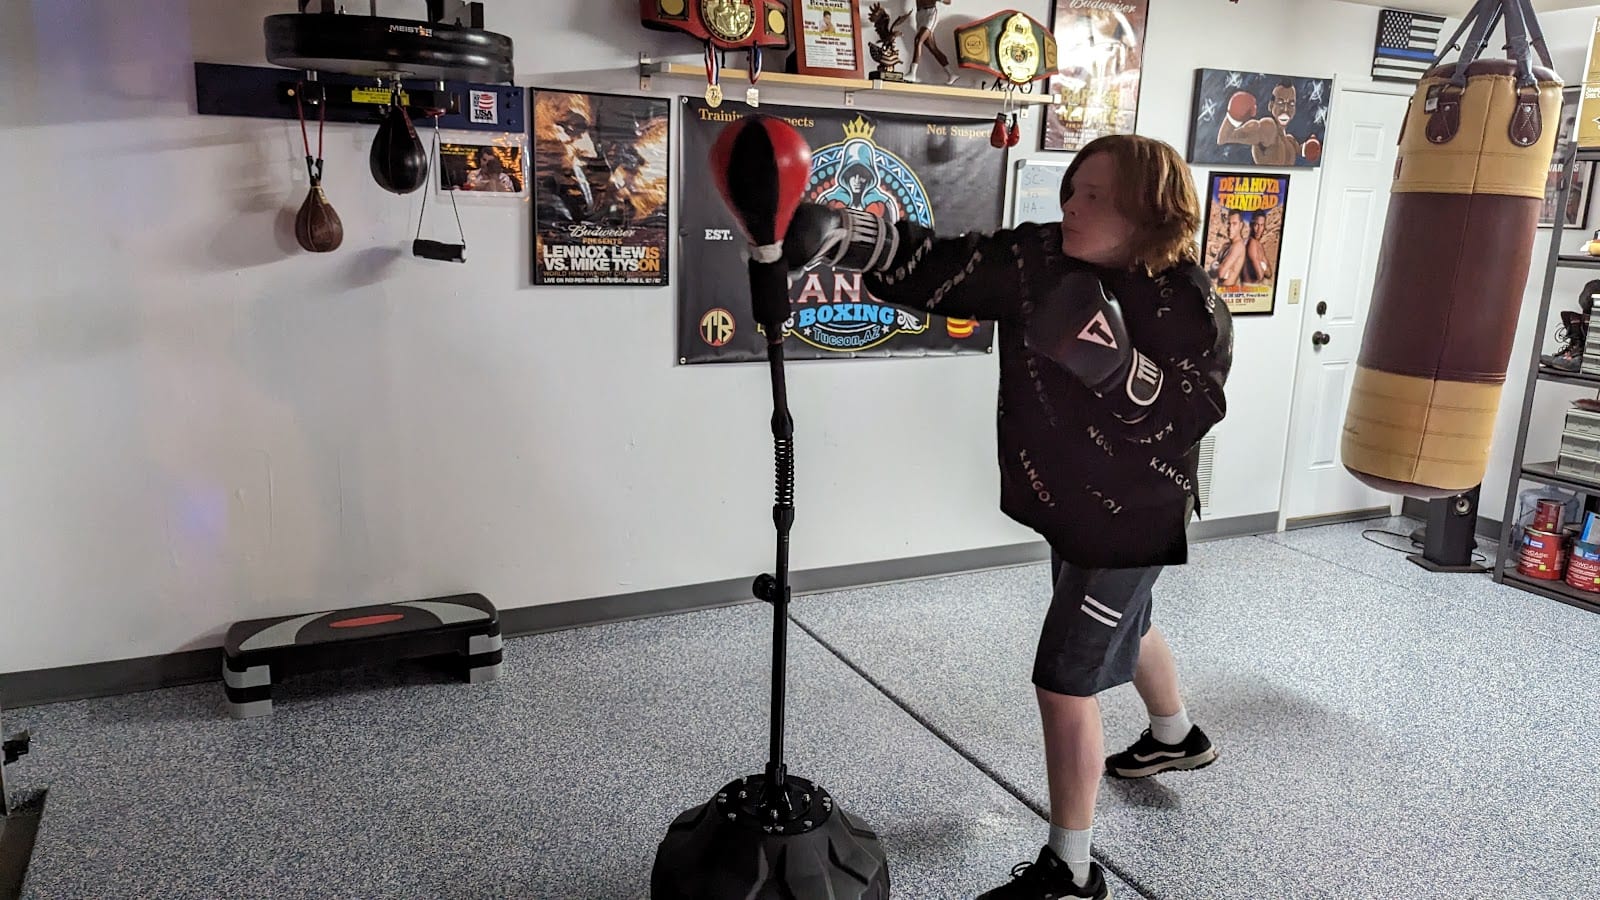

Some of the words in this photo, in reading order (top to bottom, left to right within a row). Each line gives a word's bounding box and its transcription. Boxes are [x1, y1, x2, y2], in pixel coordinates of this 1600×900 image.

[474, 109, 493, 117] USA
[698, 108, 744, 122] Traini
[926, 123, 947, 136] Not
[1219, 175, 1235, 192] DE
[1235, 176, 1249, 193] LA
[1250, 177, 1280, 193] HOYA
[1218, 193, 1279, 212] TRINIDAD
[567, 224, 637, 238] Budweiser
[704, 229, 734, 241] EST.
[582, 237, 623, 245] PRESENTS
[543, 244, 609, 259] LENNOX
[611, 246, 660, 259] LEWIS
[543, 258, 569, 271] VS.
[570, 258, 610, 272] MIKE
[611, 259, 660, 272] TYSON
[798, 303, 896, 328] BOXING
